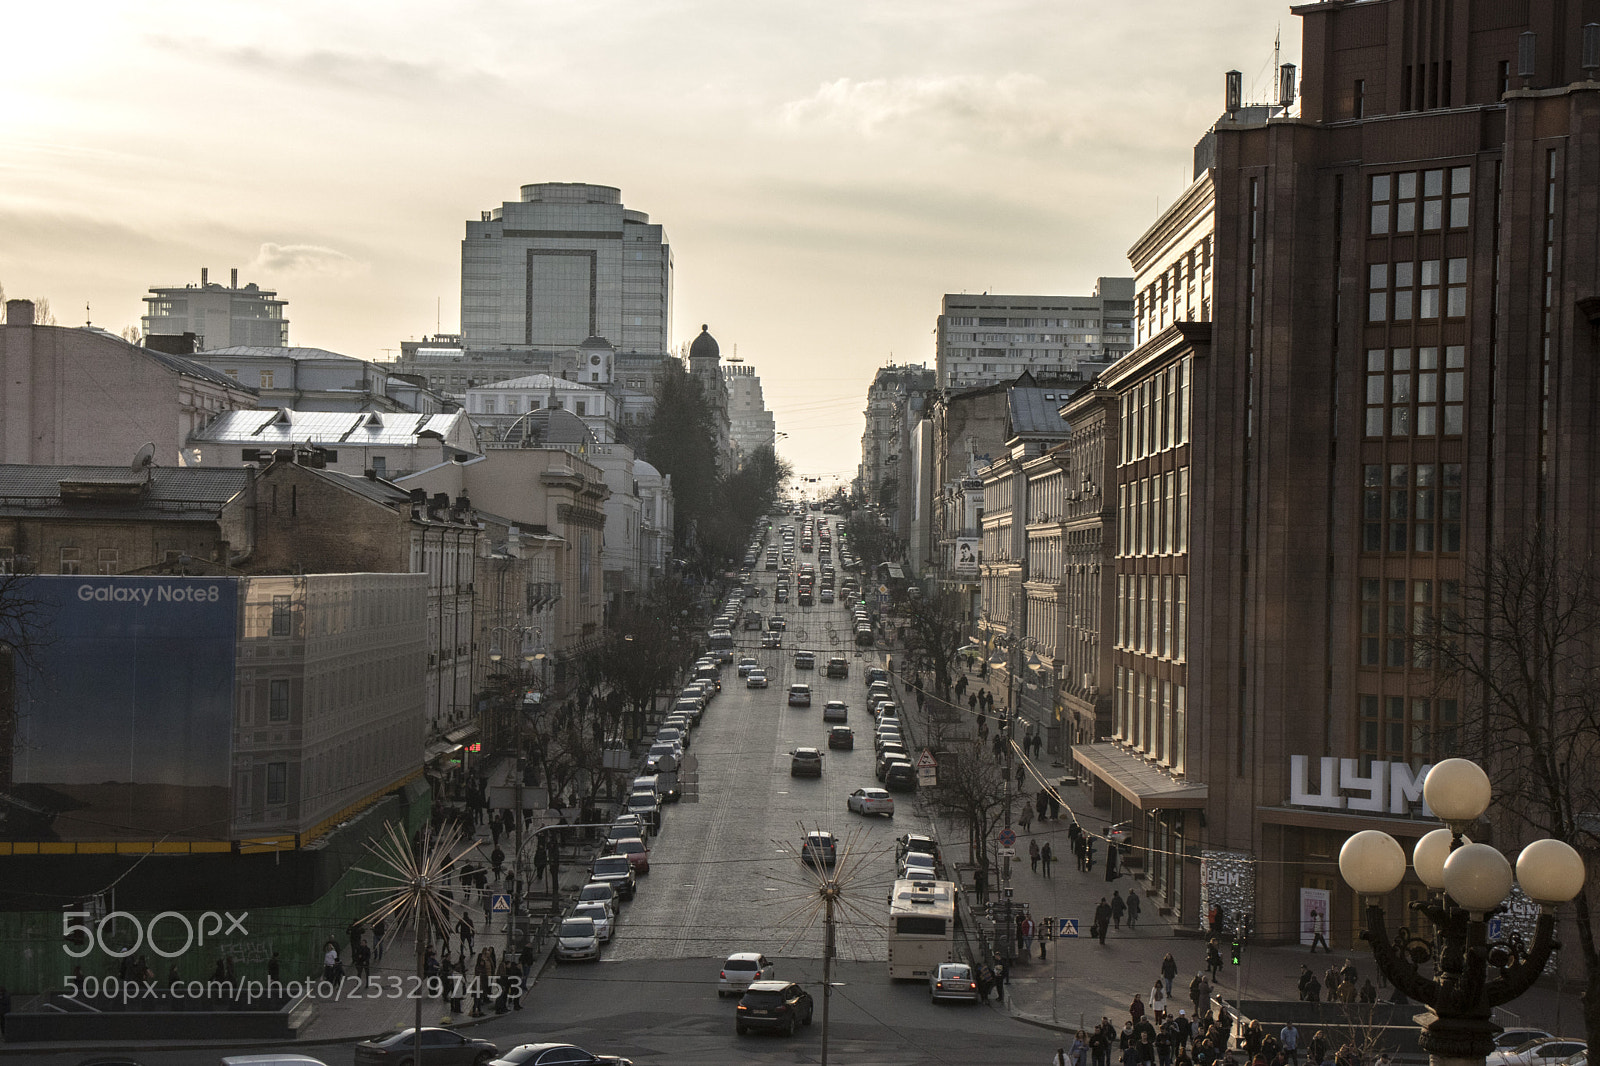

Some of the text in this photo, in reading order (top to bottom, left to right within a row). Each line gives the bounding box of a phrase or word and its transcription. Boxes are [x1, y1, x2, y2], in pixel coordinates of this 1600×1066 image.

[77, 584, 219, 607] Galaxy Note8
[1290, 754, 1437, 818] ЦУМ
[1206, 869, 1240, 886] ЦУМ
